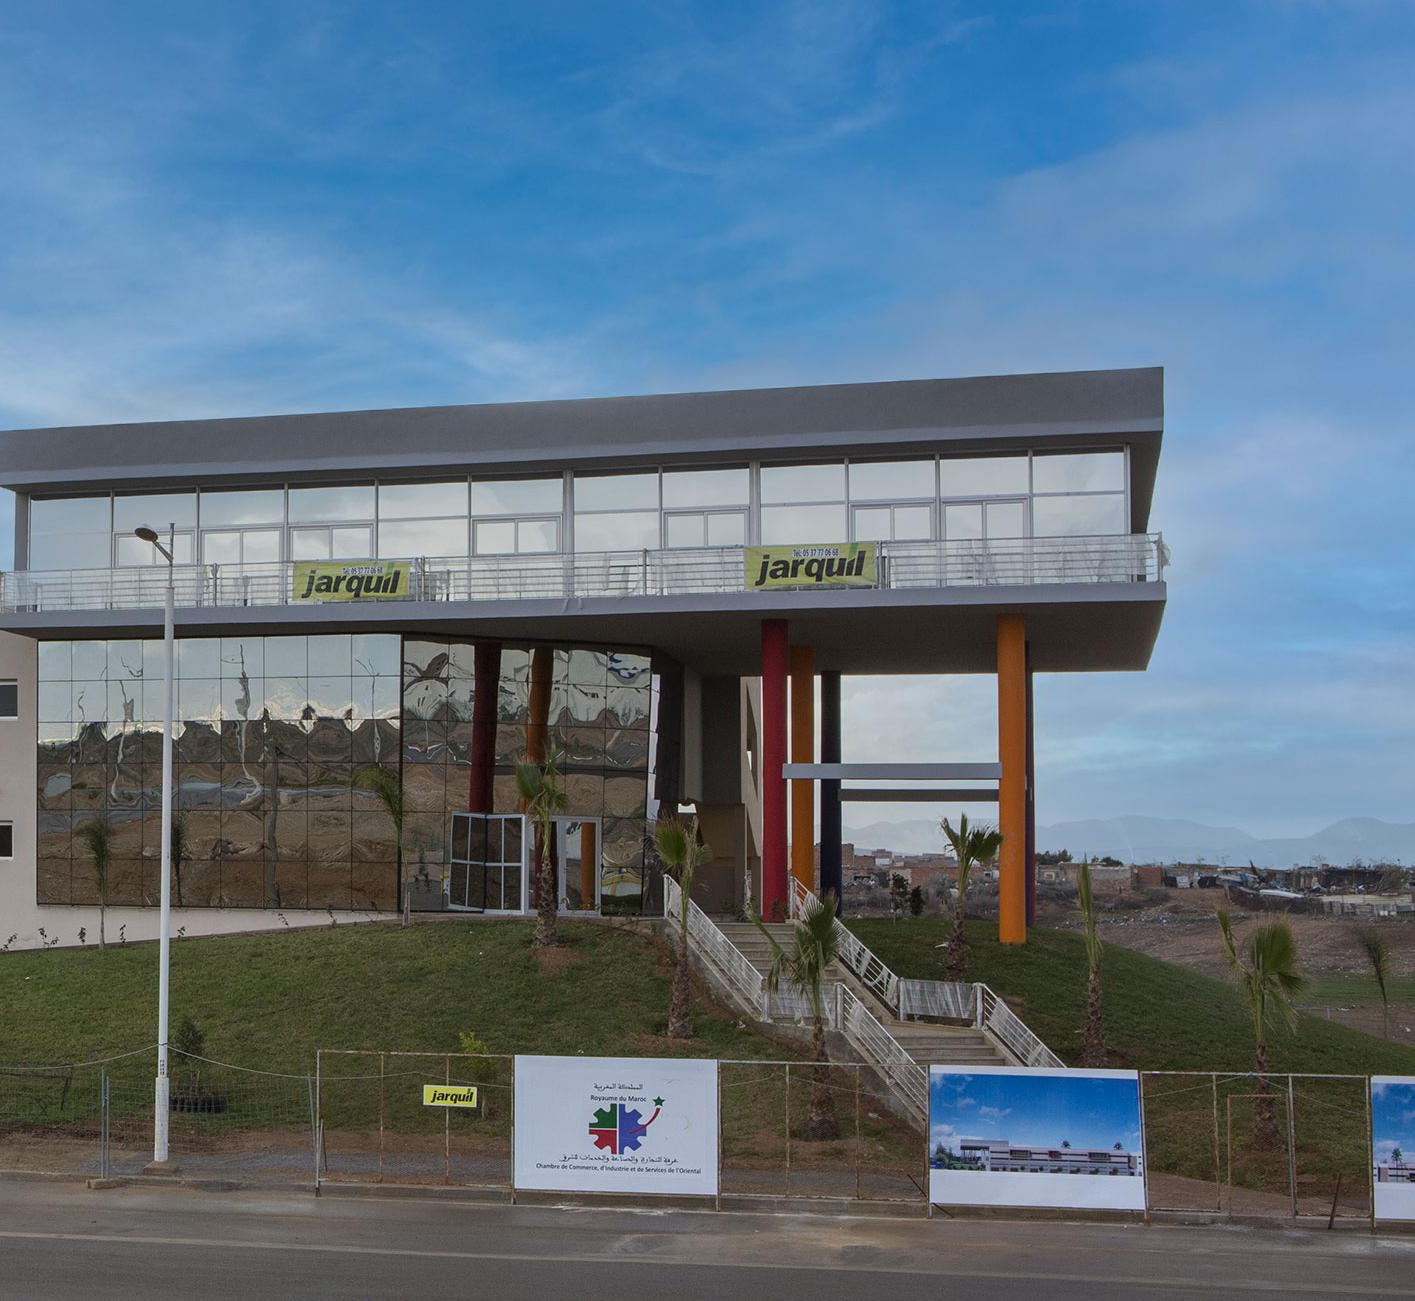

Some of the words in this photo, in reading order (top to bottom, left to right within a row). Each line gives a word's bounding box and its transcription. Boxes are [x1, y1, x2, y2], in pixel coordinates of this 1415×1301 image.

[754, 550, 866, 586] jarquil
[301, 569, 401, 598] jarquil
[430, 1089, 473, 1104] jarquil
[590, 1094, 618, 1102] Royaume
[536, 1162, 560, 1170] Chambre
[569, 1164, 600, 1172] Commerce,
